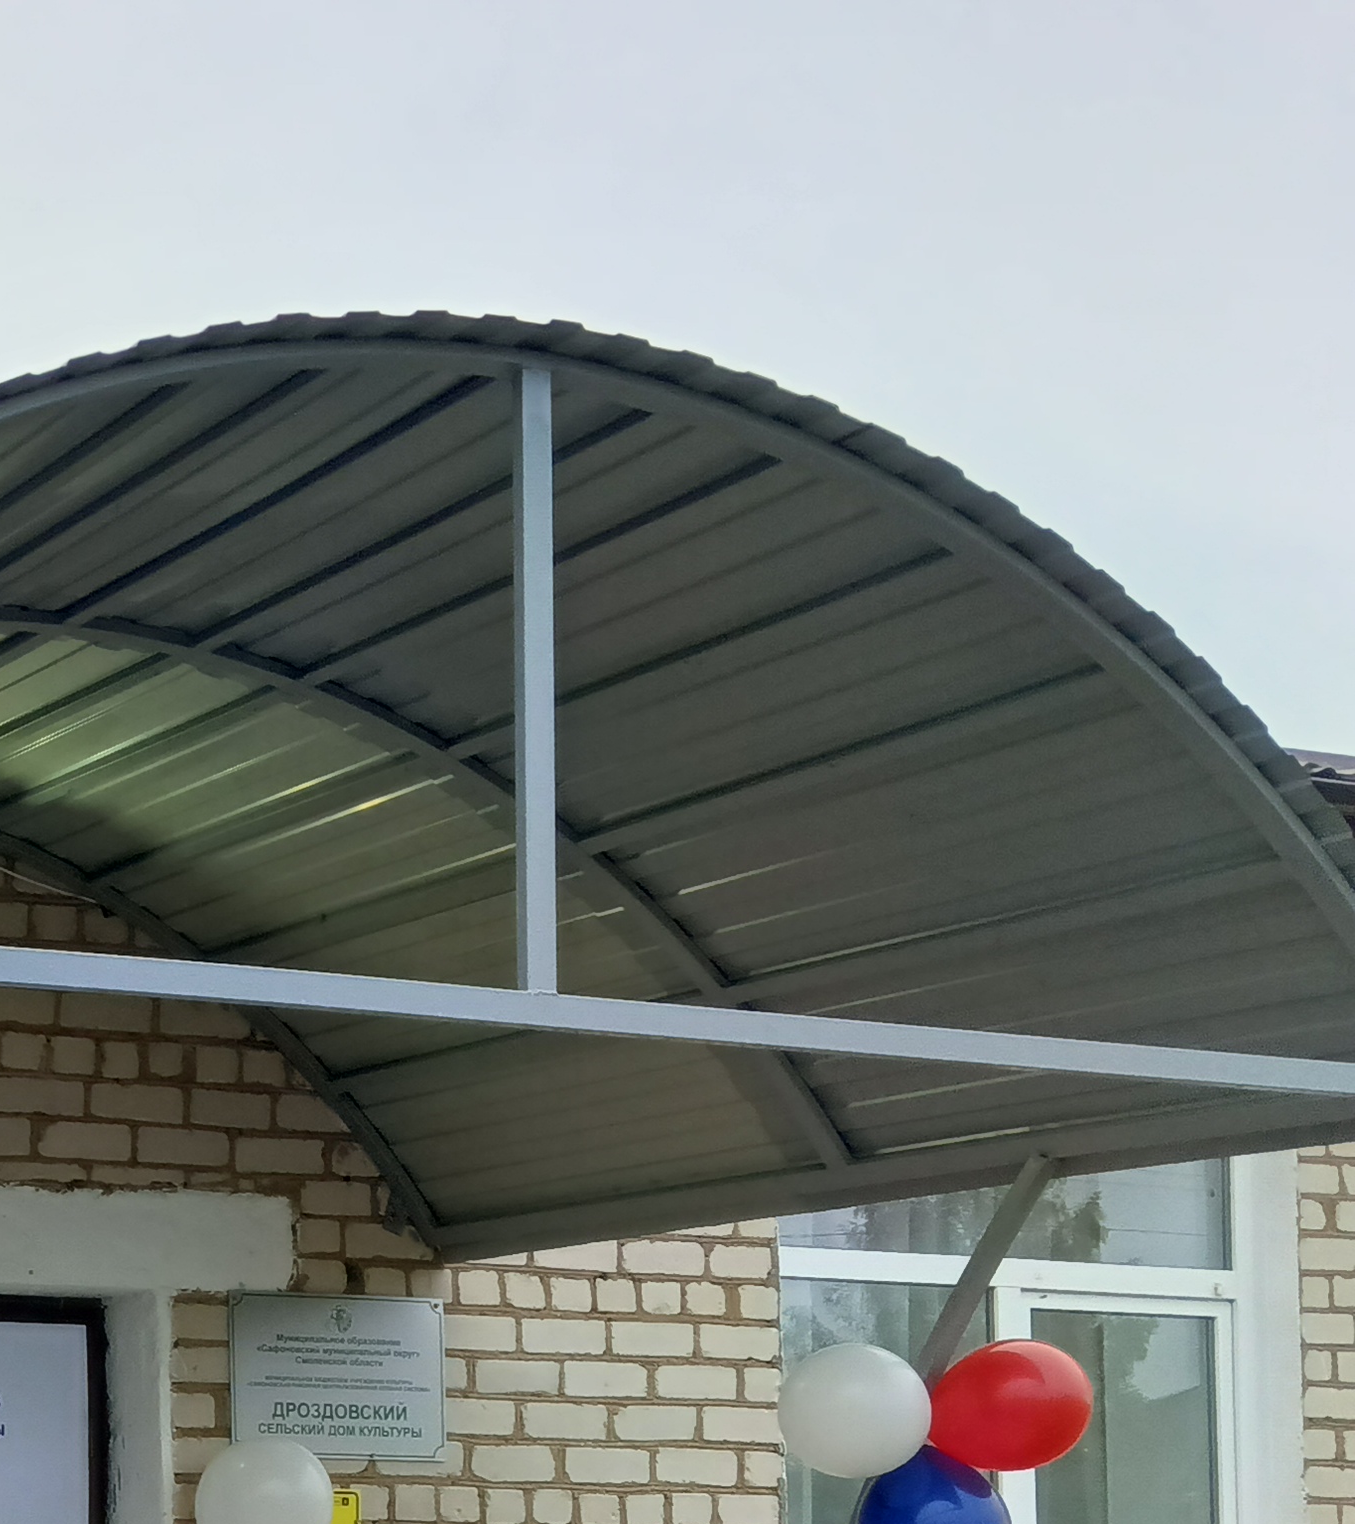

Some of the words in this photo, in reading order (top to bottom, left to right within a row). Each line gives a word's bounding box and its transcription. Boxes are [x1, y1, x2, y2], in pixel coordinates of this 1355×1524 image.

[272, 1402, 408, 1421] ДРОЗДОВСКИЙ
[258, 1422, 325, 1435] СЕЛЬСКИЙ
[328, 1425, 355, 1437] ДОМ
[359, 1426, 422, 1438] КУЛЬТУРЫ
